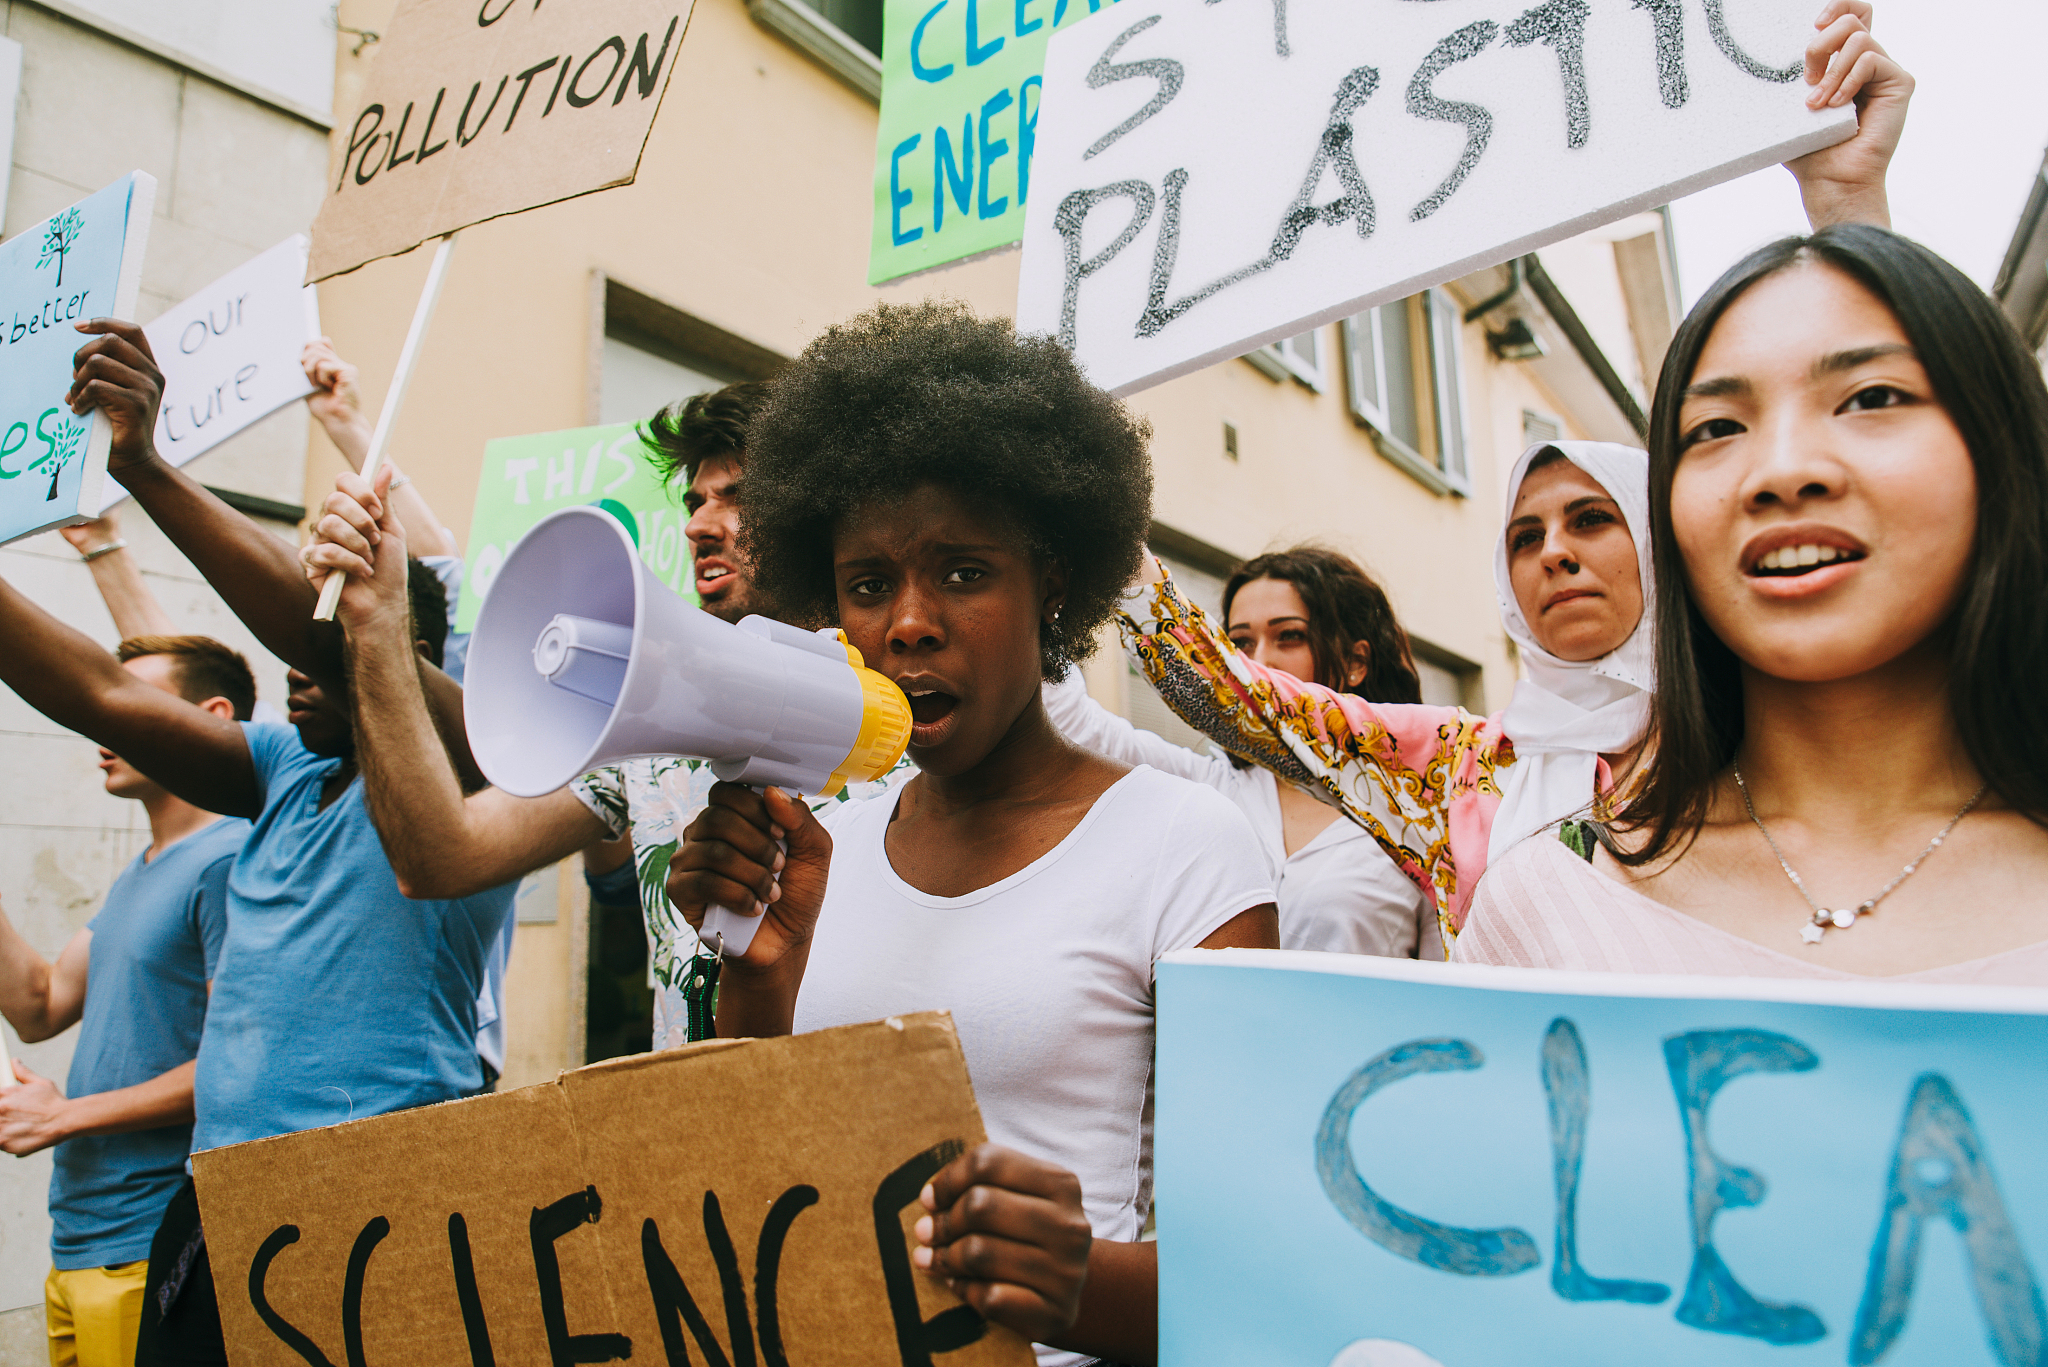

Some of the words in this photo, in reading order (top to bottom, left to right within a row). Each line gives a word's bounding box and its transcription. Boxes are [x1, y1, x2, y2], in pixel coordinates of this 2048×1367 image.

[335, 15, 679, 193] POLLUTION
[9, 290, 91, 344] better
[179, 292, 249, 354] our
[504, 429, 643, 505] THIS
[248, 1138, 990, 1367] SCIENCE
